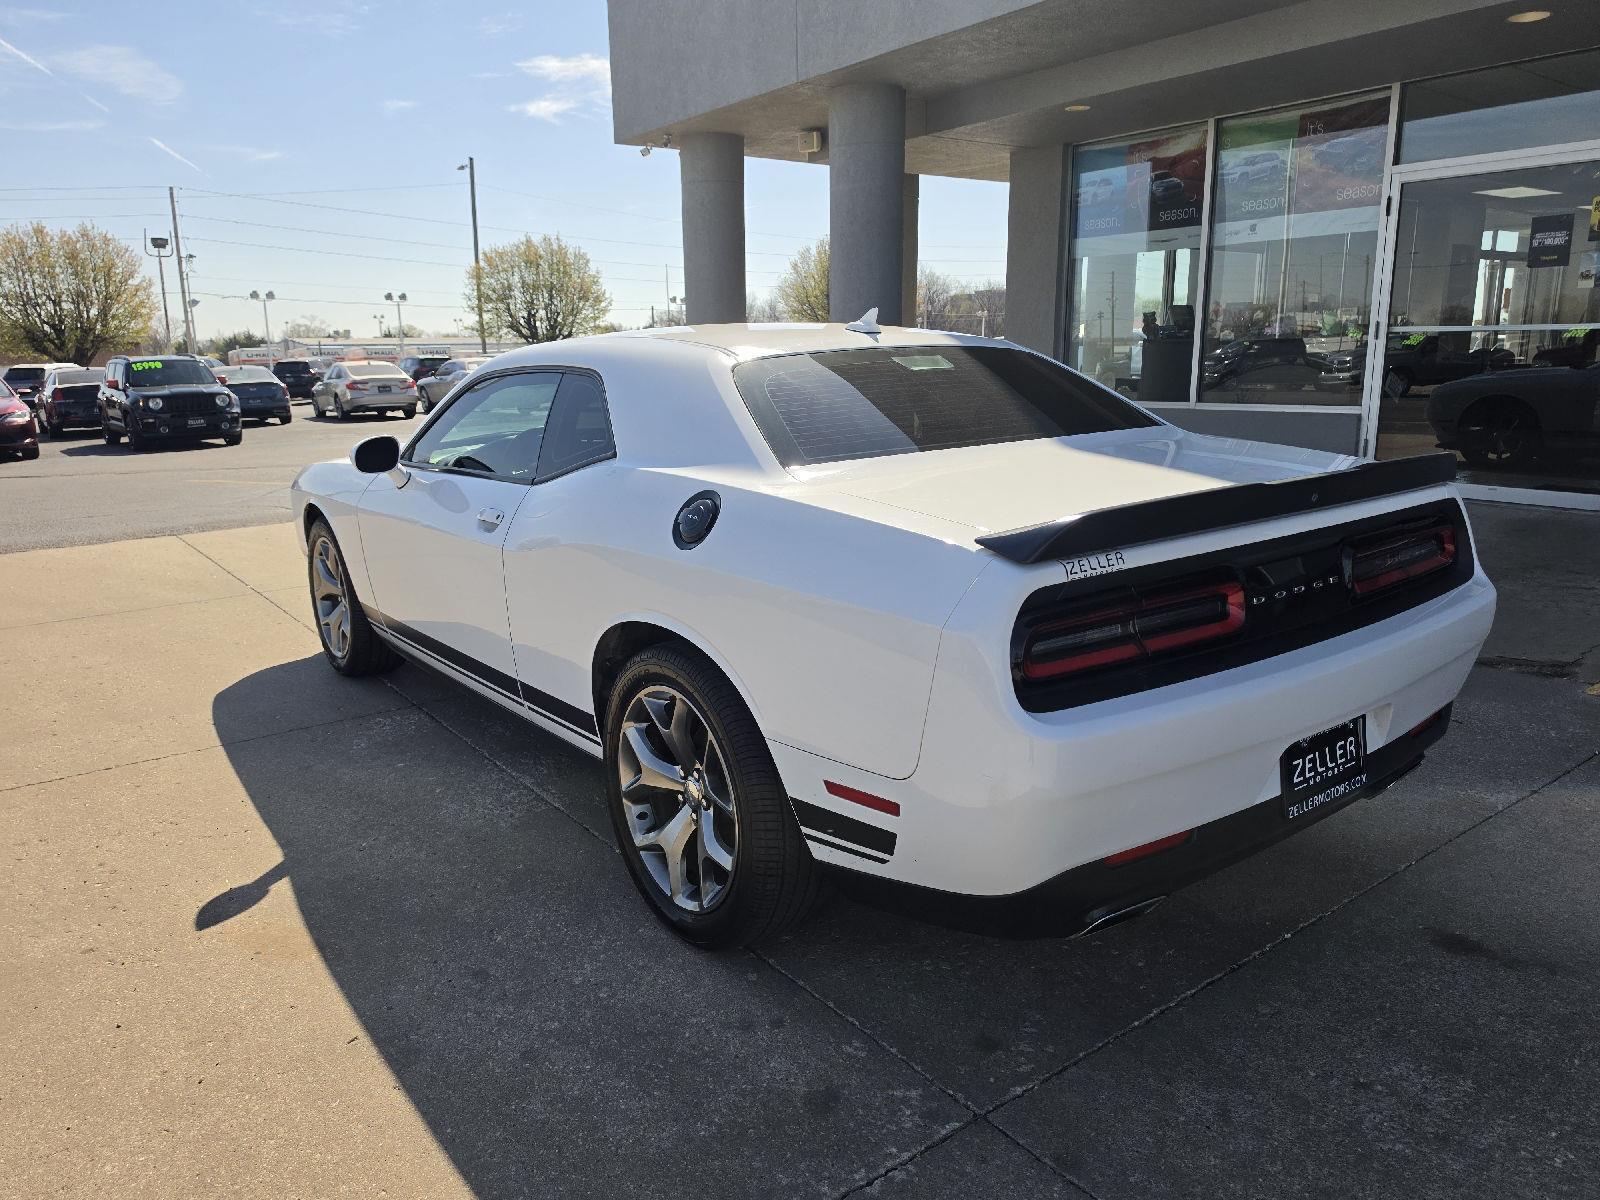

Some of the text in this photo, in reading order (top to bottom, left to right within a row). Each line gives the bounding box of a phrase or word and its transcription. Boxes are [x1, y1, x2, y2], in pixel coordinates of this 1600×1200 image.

[1084, 217, 1121, 231] season.
[1159, 207, 1199, 222] season.
[1066, 551, 1126, 576] ZELLER
[1252, 575, 1339, 605] DODGE
[1292, 736, 1357, 784] ZELLER
